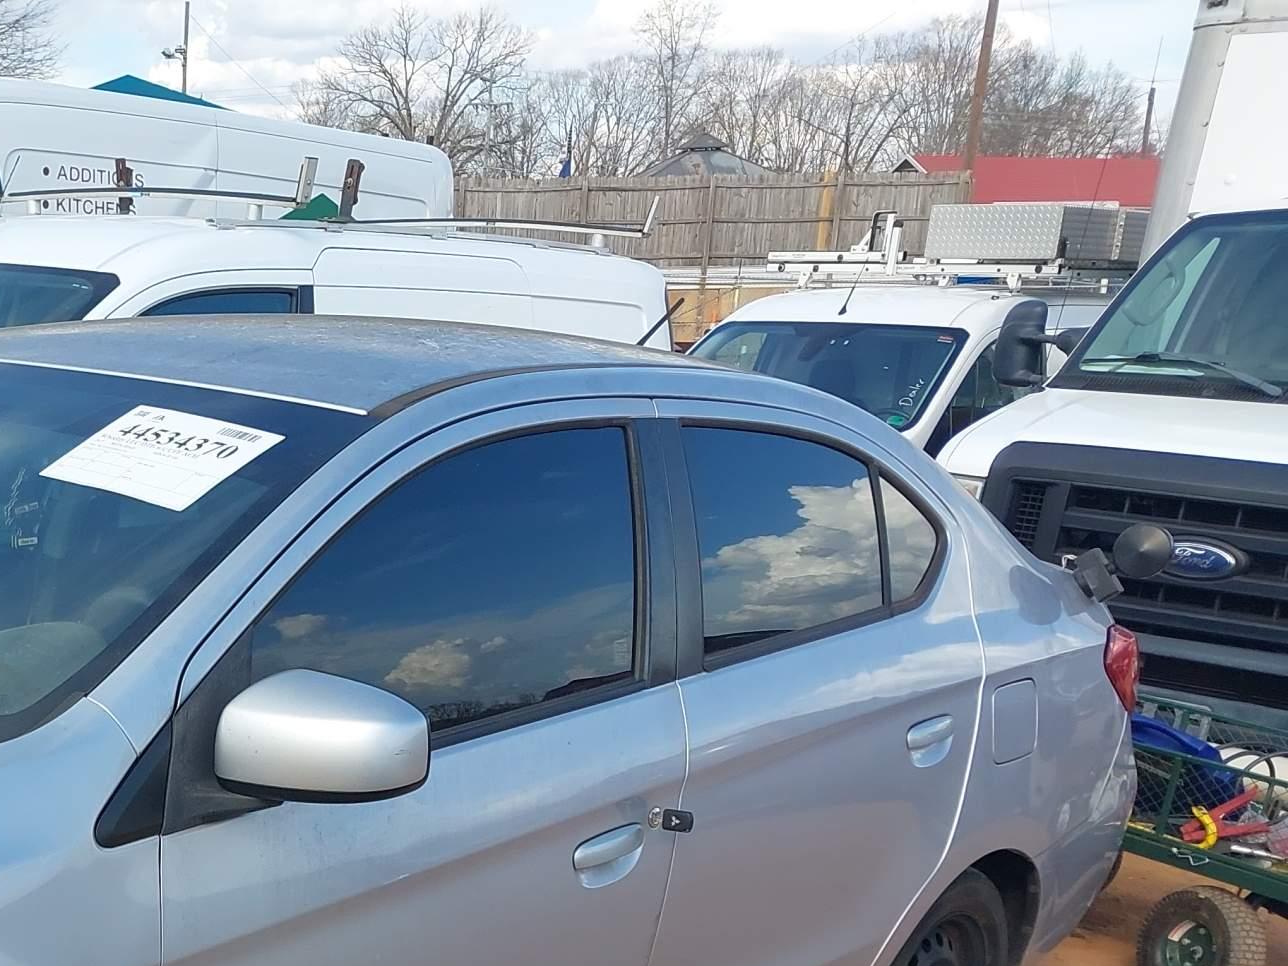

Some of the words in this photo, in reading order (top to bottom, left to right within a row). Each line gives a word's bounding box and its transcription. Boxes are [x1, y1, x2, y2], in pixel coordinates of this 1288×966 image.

[57, 165, 145, 190] ADDITIS
[119, 424, 240, 460] 44534370
[1174, 547, 1216, 569] Ford
